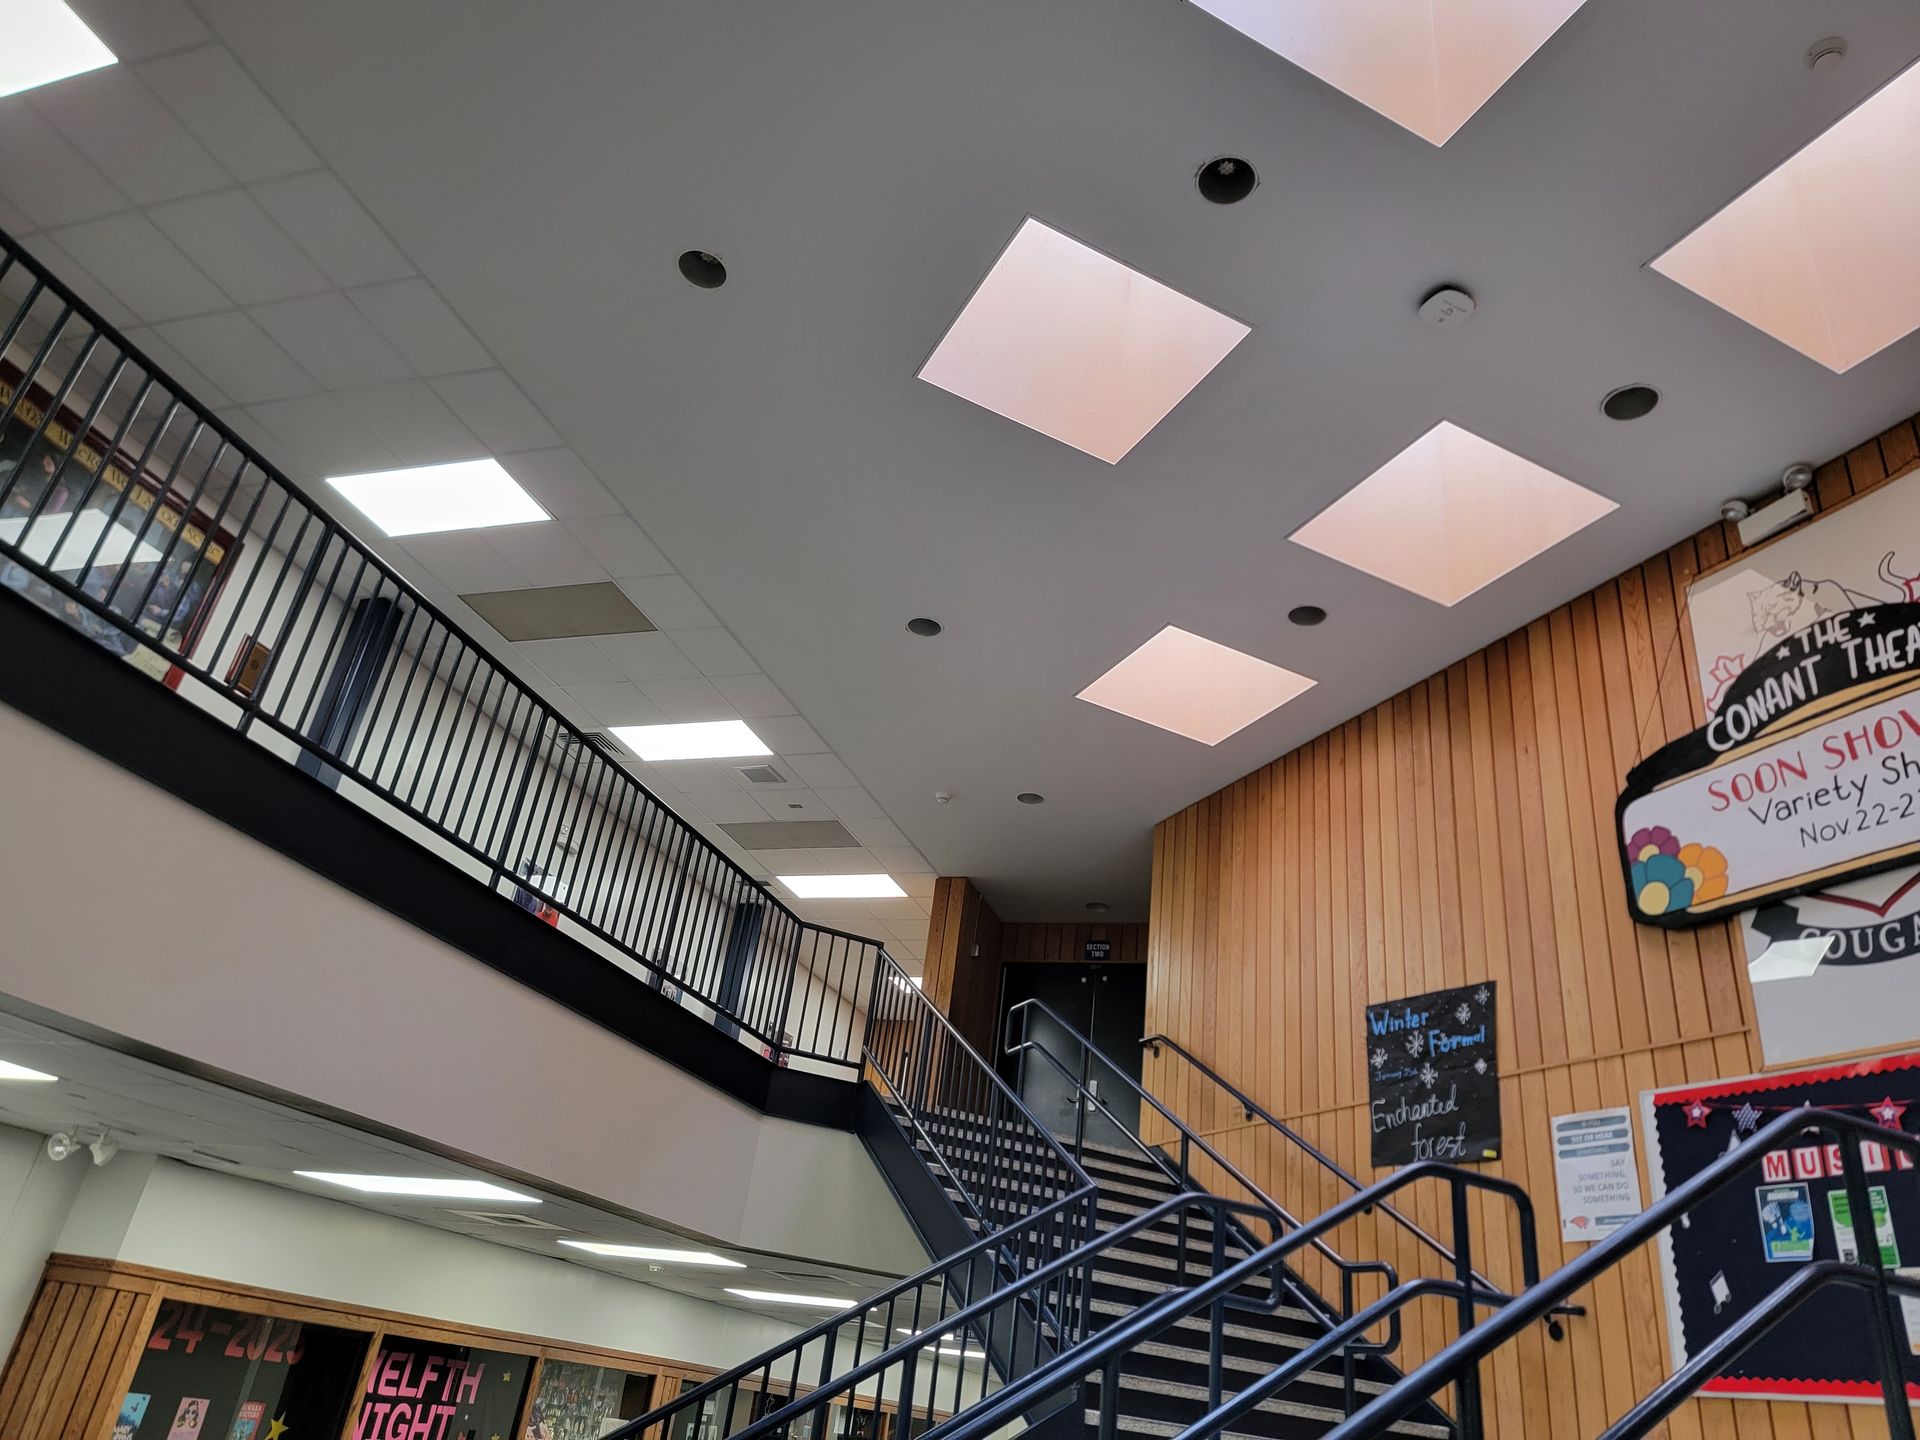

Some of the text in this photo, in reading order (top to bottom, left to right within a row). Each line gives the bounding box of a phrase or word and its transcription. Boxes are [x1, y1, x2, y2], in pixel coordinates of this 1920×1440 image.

[1794, 612, 1852, 654] THE
[1706, 622, 1920, 752] CONANT THEA
[1708, 751, 1808, 811] SOON
[1748, 774, 1868, 825] Variety
[1855, 789, 1920, 832] 22-2
[1368, 1008, 1429, 1036] Winter
[1427, 1024, 1486, 1057] Formal
[1371, 1083, 1460, 1133] Enchanted
[1411, 1121, 1467, 1162] forest
[1584, 1134, 1593, 1142] OR
[1610, 1159, 1626, 1167] SAY
[1573, 1181, 1629, 1194] SO WE CAN DO
[1583, 1192, 1631, 1204] SOMETHING
